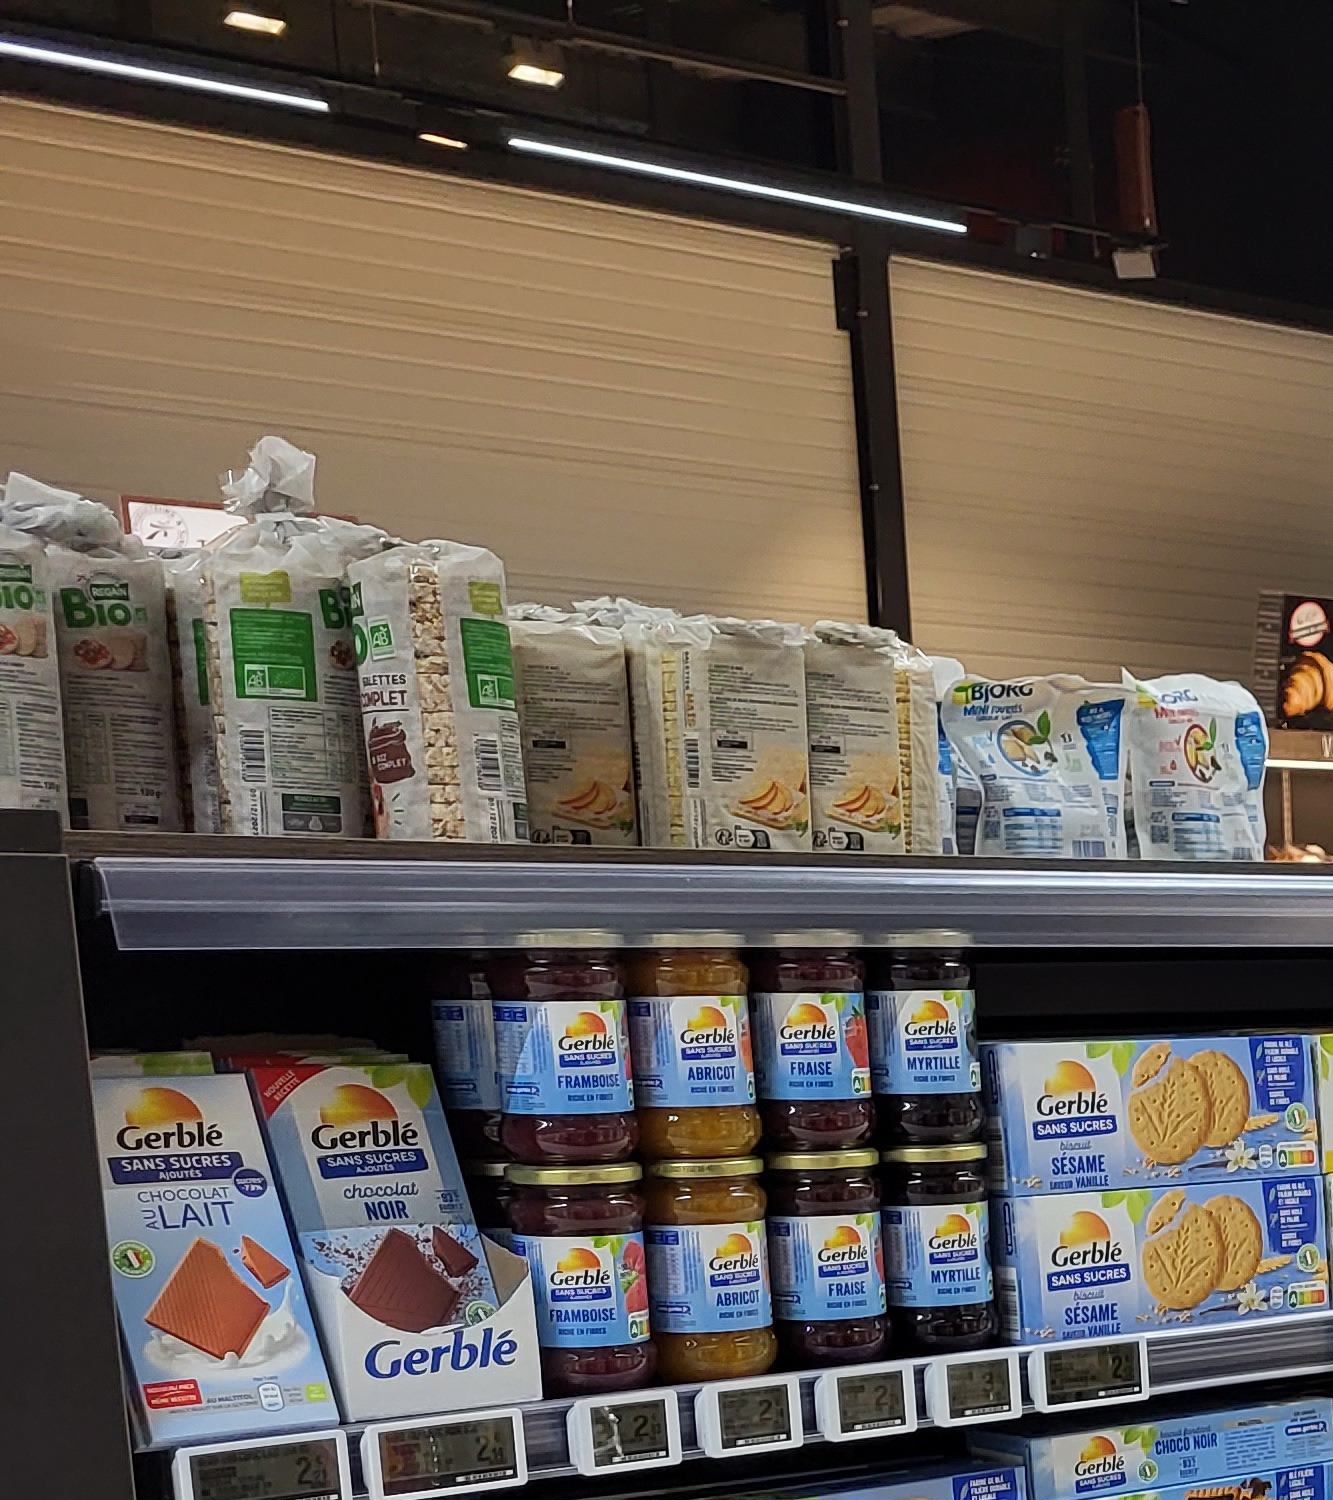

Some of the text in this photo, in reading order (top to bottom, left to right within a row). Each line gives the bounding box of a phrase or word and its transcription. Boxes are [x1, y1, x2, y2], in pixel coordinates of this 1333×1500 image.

[790, 1060, 832, 1076] FRAISE
[907, 1055, 960, 1071] MYRTILLE
[557, 1073, 620, 1089] FRAMBOISE
[687, 1065, 735, 1081] ABRICOT
[1037, 1093, 1108, 1116] Gerblé
[115, 1124, 224, 1151] Gerblé
[312, 1122, 420, 1150] Gerblé
[121, 1153, 232, 1172] SANS SUCRES
[326, 1151, 417, 1167] SANS SUCRES
[1051, 1154, 1105, 1176] SÉSAME
[137, 1186, 230, 1203] CHOCOLAT
[343, 1181, 419, 1201] chocolat
[161, 1201, 234, 1230] LAIT
[364, 1201, 410, 1222] NOIR
[1051, 1242, 1122, 1267] Gerblé
[931, 1267, 981, 1283] MYRTILLE
[716, 1289, 760, 1306] ABRICOT
[828, 1281, 866, 1297] FRAISE
[549, 1306, 616, 1323] FRAMBOISE
[1064, 1304, 1119, 1326] SÉSAME
[365, 1328, 519, 1379] Gerblé
